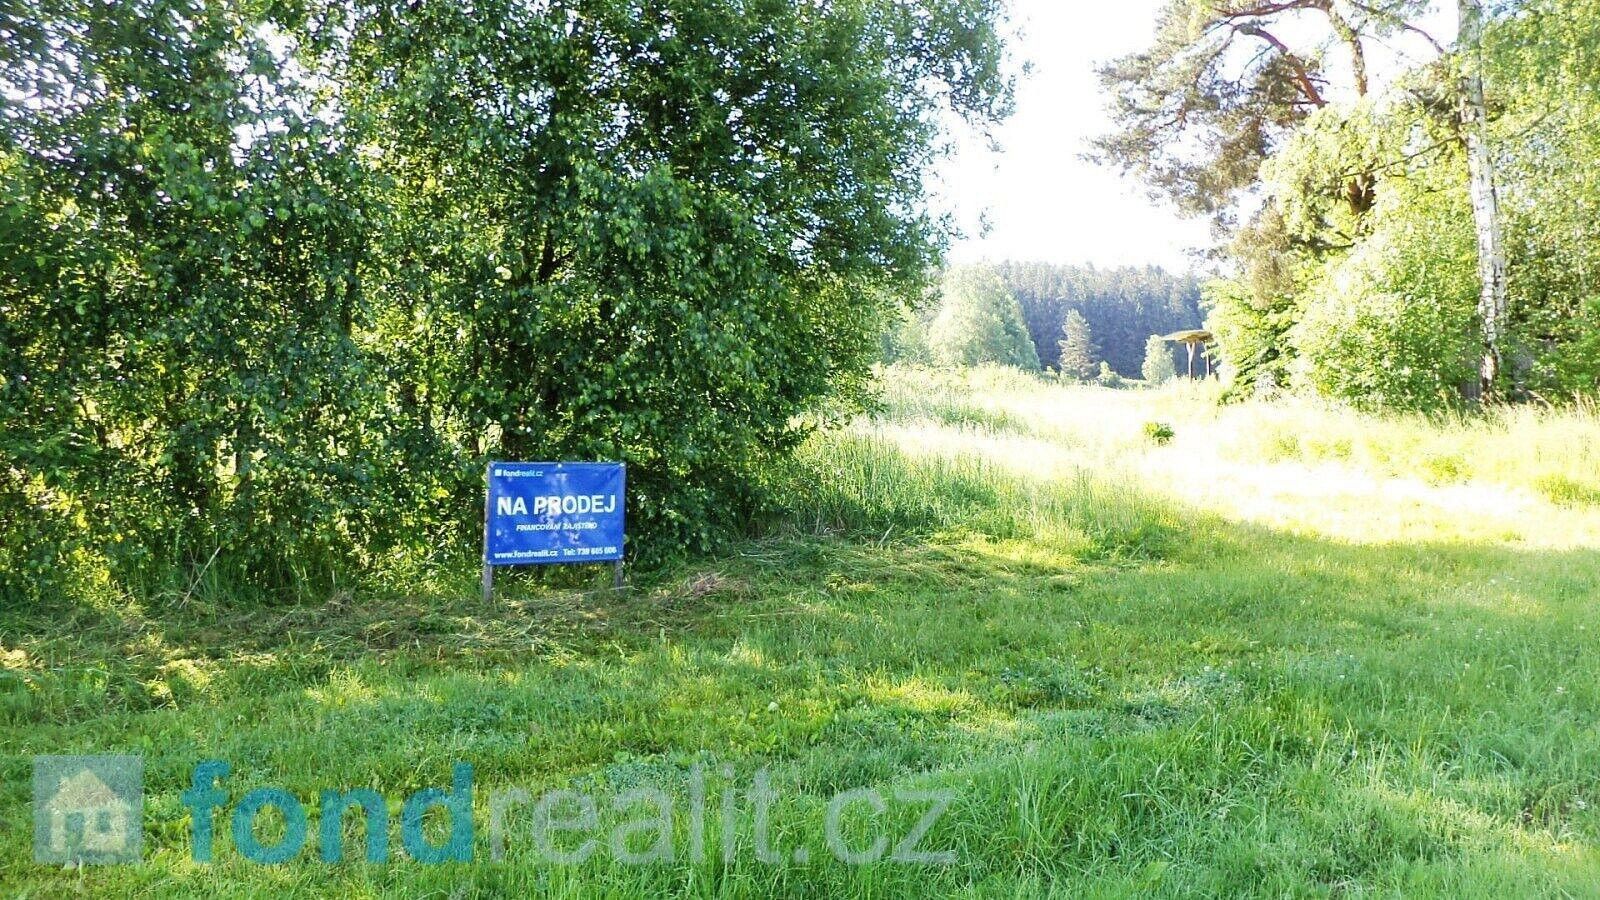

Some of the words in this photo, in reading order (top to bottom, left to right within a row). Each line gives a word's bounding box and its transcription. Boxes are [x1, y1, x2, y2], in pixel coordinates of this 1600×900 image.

[497, 496, 528, 515] NA
[533, 494, 616, 515] PRODEJ
[494, 549, 559, 558] www.fondrealit.cz
